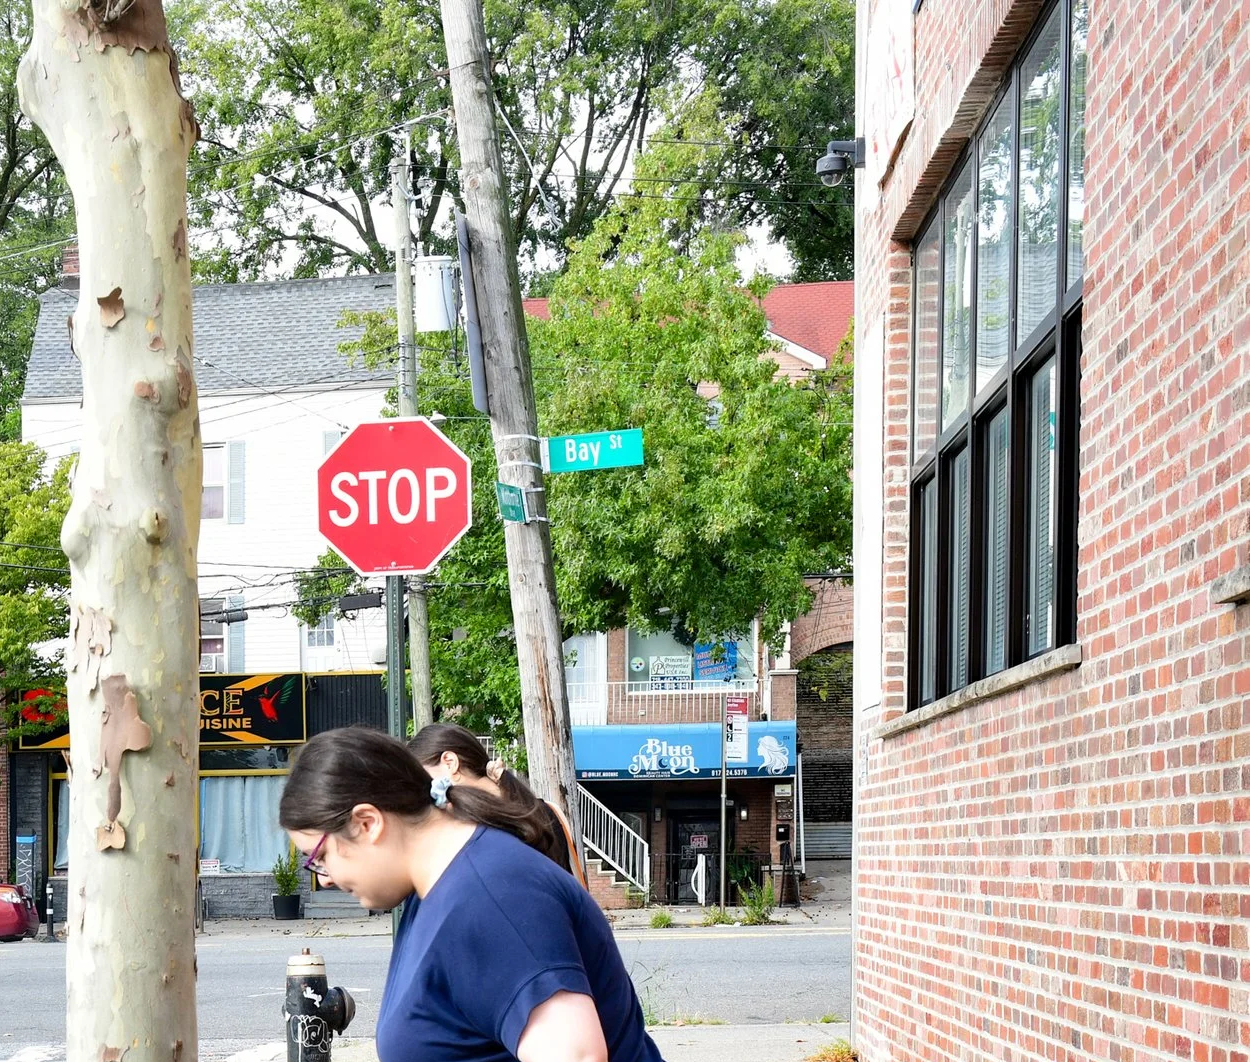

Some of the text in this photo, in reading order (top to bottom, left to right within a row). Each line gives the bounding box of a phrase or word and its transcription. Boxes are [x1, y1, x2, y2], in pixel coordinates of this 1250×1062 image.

[564, 433, 623, 467] Bay St
[328, 466, 458, 528] STOP
[199, 689, 245, 717] CE
[646, 738, 692, 757] Blue
